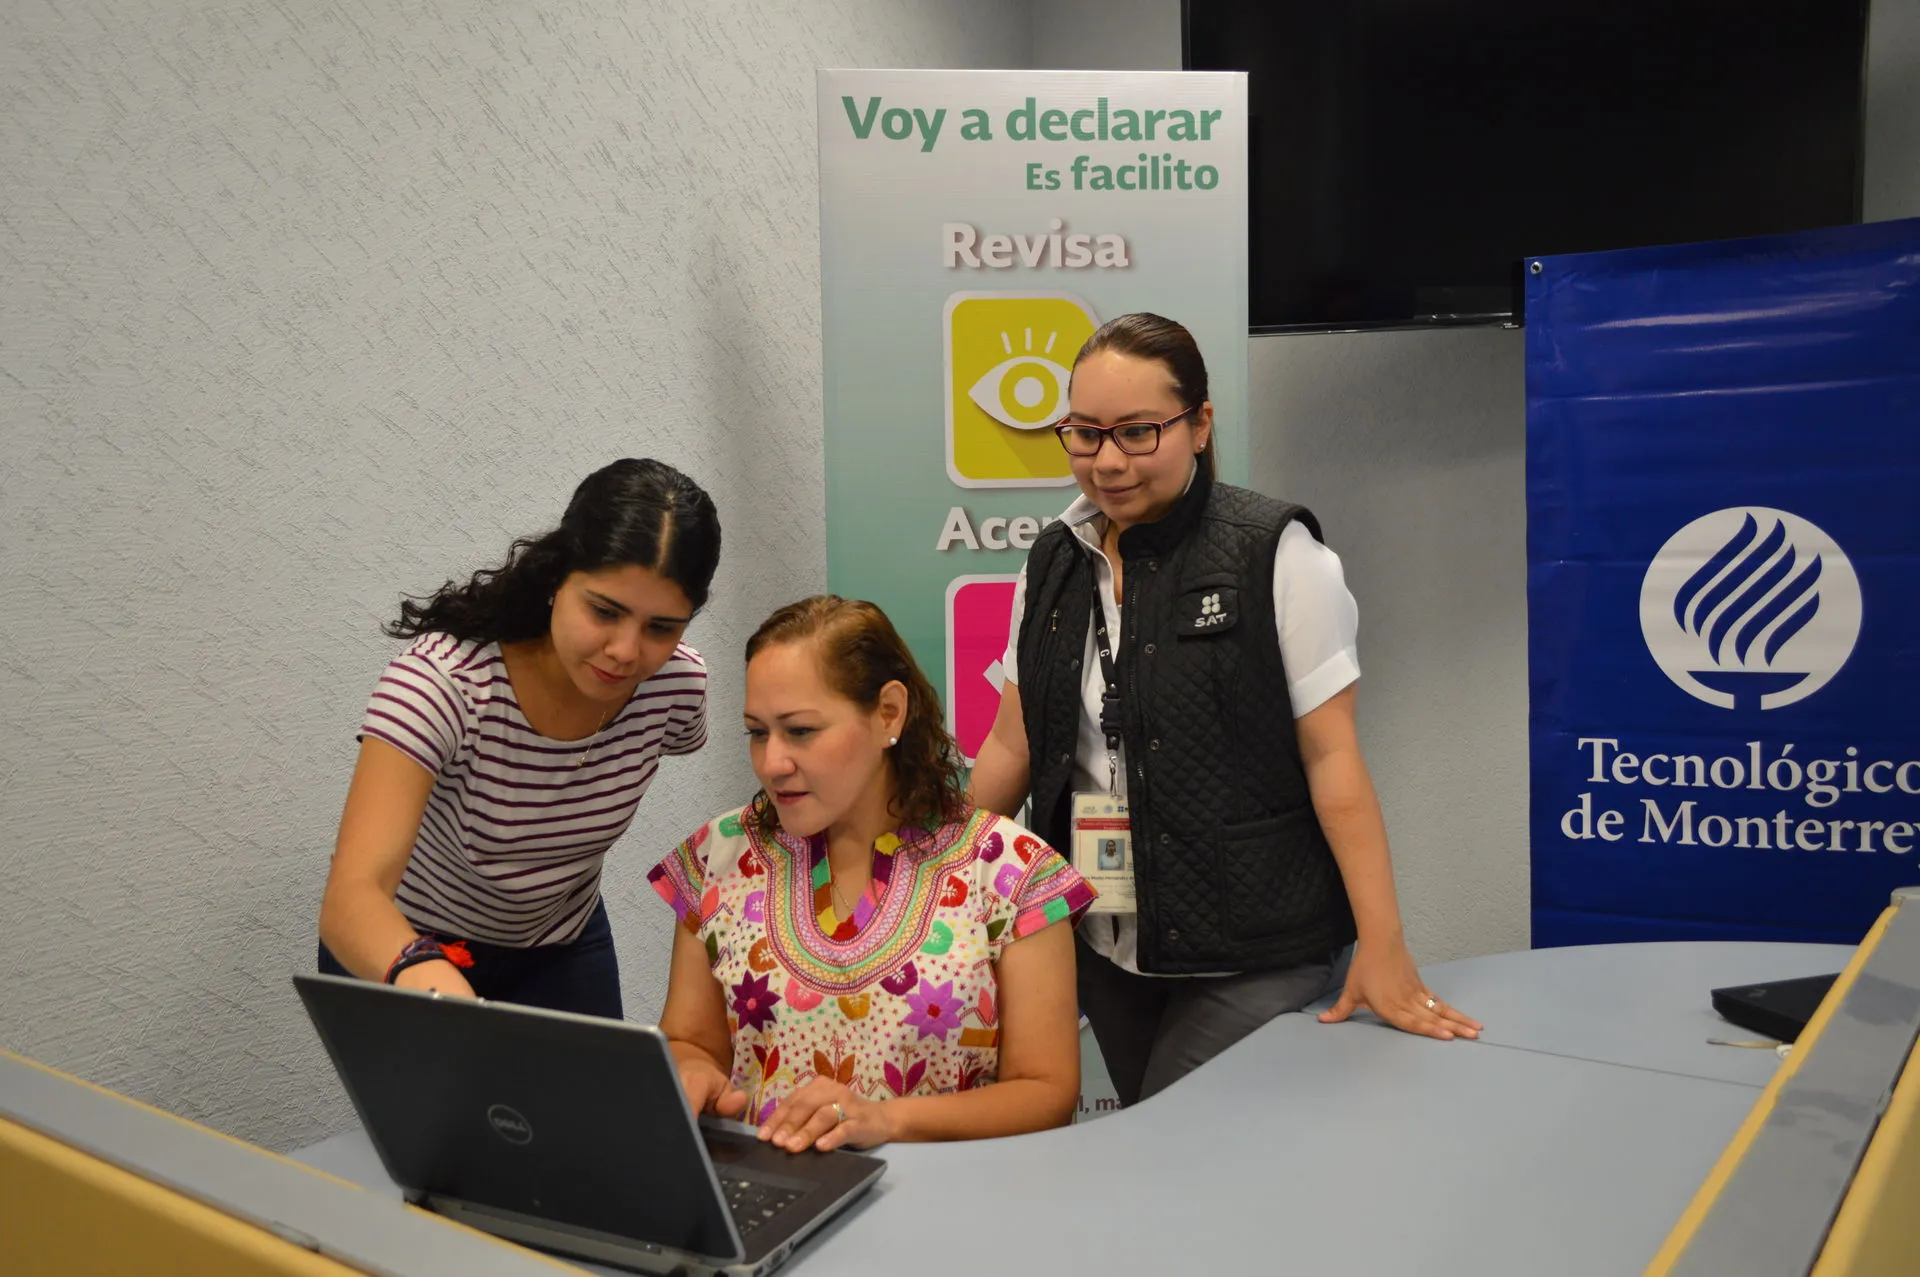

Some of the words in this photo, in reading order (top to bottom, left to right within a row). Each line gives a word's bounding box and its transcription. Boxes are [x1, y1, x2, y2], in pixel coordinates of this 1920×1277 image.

[842, 96, 946, 152] Voy
[960, 109, 992, 141] a
[1006, 97, 1222, 141] declarar
[1026, 163, 1061, 191] Es
[1071, 154, 1219, 190] facilito
[943, 218, 1129, 268] Revisa
[1194, 613, 1227, 628] SAT
[1578, 738, 1920, 808] Tecnológico
[1561, 793, 1625, 841] de
[1638, 799, 1920, 858] Monterre
